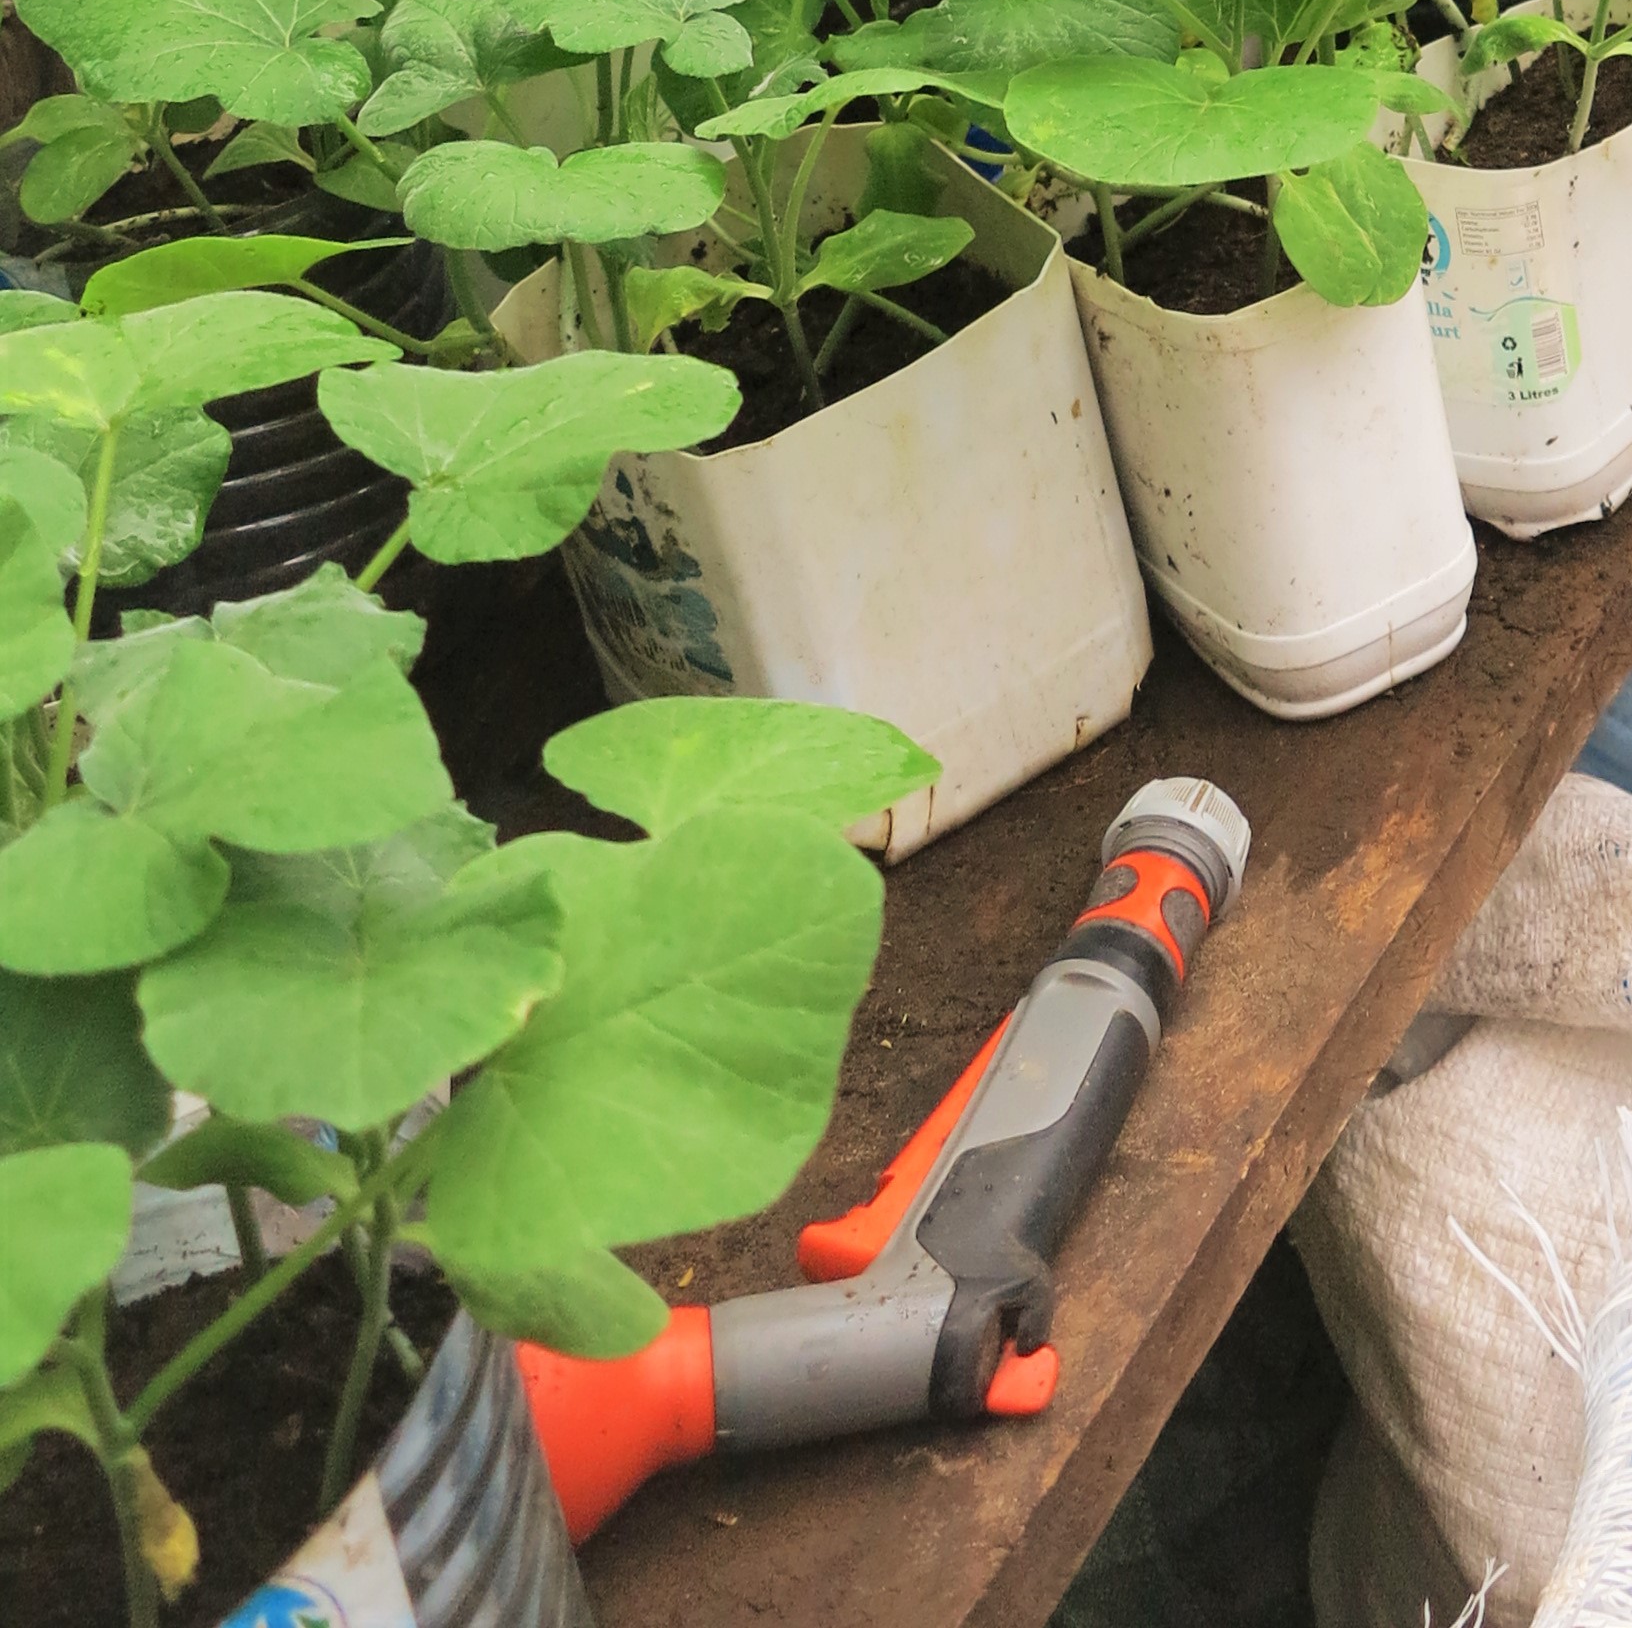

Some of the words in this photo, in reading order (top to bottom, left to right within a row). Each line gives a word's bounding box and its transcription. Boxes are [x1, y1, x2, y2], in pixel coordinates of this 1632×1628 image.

[1426, 301, 1453, 319] lla
[1430, 326, 1461, 340] urt
[1507, 391, 1517, 401] 3
[1520, 387, 1560, 401] Litres
